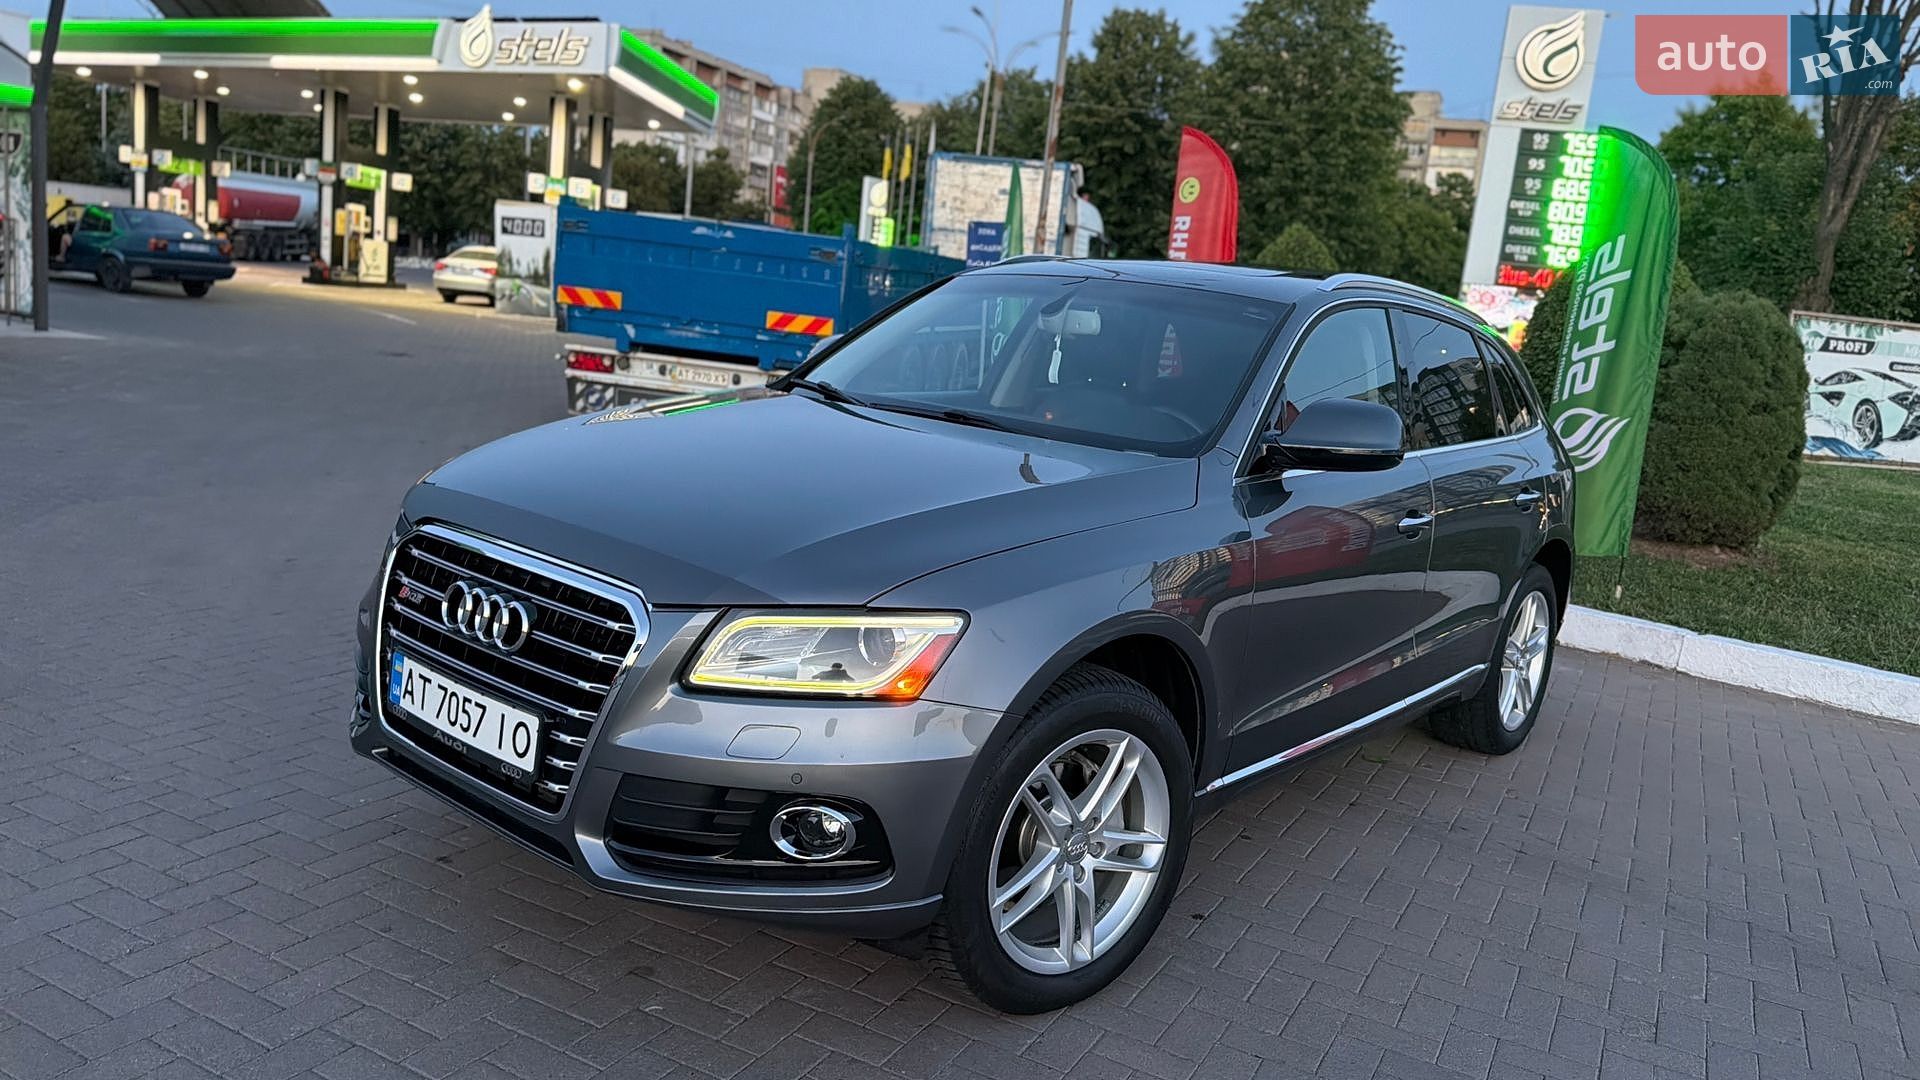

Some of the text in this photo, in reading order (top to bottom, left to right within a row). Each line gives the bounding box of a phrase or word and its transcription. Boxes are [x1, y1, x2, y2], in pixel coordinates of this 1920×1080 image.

[495, 27, 590, 65] stels
[1497, 96, 1585, 124] stels
[1533, 132, 1550, 144] 95
[1527, 157, 1546, 171] 95
[1524, 177, 1542, 190] 95
[1509, 199, 1541, 212] DIESEL
[502, 218, 543, 236] 4000
[1508, 225, 1541, 238] DIESEL
[1505, 243, 1538, 256] DIESEL
[1828, 339, 1867, 353] PROFI
[392, 681, 401, 696] UA
[402, 668, 531, 759] AT 7057 IO
